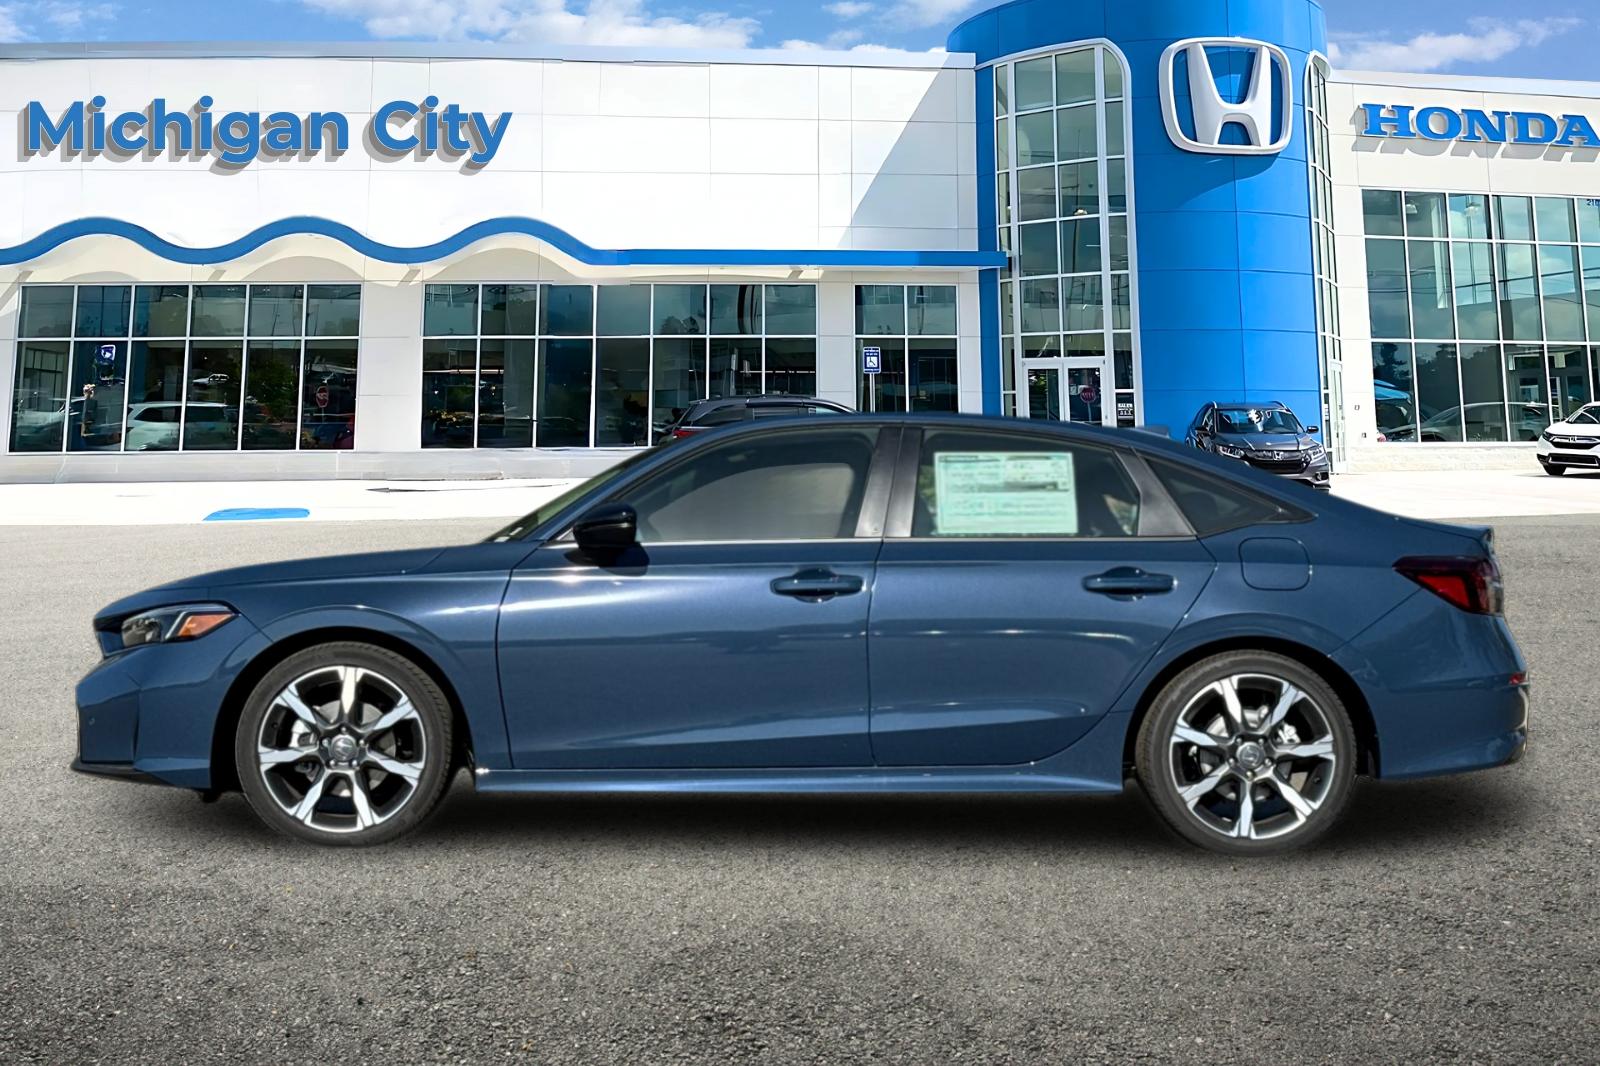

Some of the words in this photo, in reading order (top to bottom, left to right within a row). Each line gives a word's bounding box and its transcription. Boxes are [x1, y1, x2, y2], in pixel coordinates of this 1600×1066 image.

[27, 95, 350, 164] Michigan
[373, 95, 513, 165] City
[1361, 102, 1600, 149] HONDA
